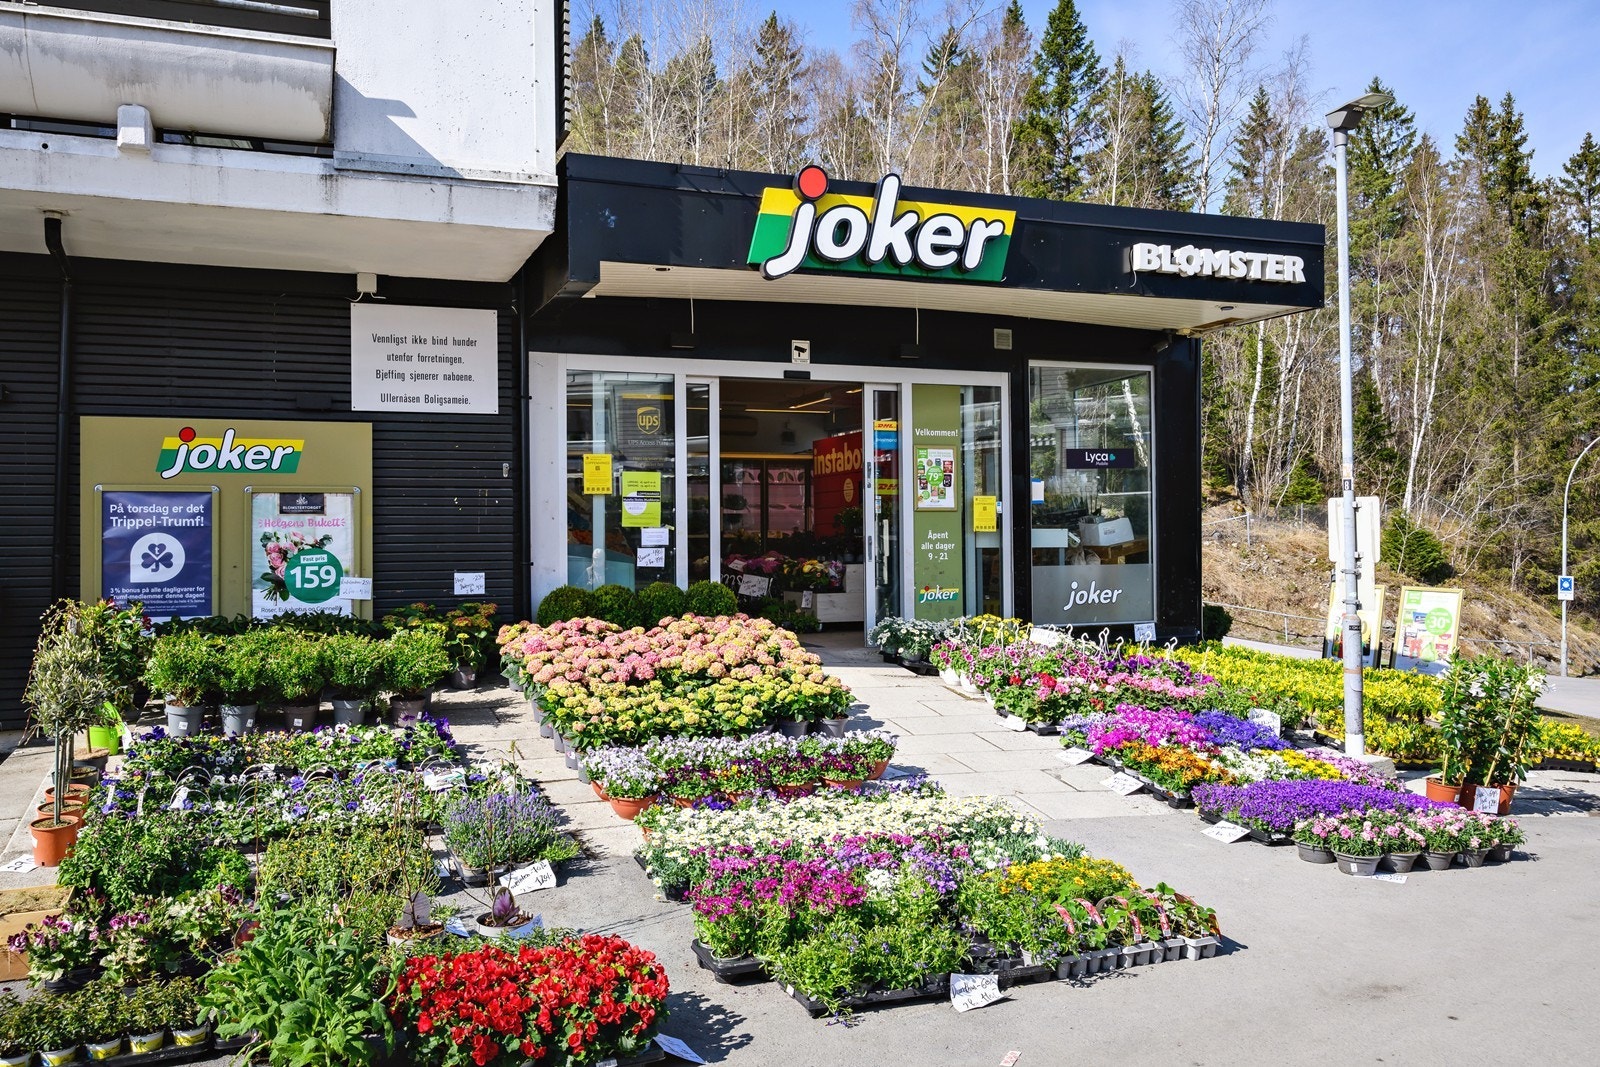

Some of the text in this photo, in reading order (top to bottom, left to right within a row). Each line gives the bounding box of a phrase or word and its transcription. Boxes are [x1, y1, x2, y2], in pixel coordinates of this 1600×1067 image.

[759, 164, 1005, 280] joker
[371, 333, 477, 347] Vennligst ikke bind hunder
[386, 352, 465, 365] utenfor forretningen.
[375, 369, 475, 382] Bjeffing sjenerer naboene.
[380, 392, 471, 406] Ullernåsen Boligsameie.
[640, 415, 659, 430] ups
[915, 428, 958, 437] Velkommen!
[161, 427, 295, 480] joker
[813, 442, 863, 475] instabo
[1085, 451, 1109, 463] Lyca
[109, 503, 124, 513] På
[127, 504, 169, 515] torsdag
[186, 504, 205, 513] det
[109, 516, 205, 529] Trippel-Trumf!
[264, 518, 340, 529] Helgens Bukett
[927, 529, 949, 540] Åpent
[921, 541, 955, 551] alle dager
[928, 552, 933, 560] 9
[939, 552, 949, 560] 21
[290, 565, 337, 589] 159
[141, 587, 149, 595] på
[162, 586, 195, 595] dagligvarer
[184, 592, 205, 600] dagen!
[920, 584, 956, 604] joker
[1063, 580, 1123, 611] joker
